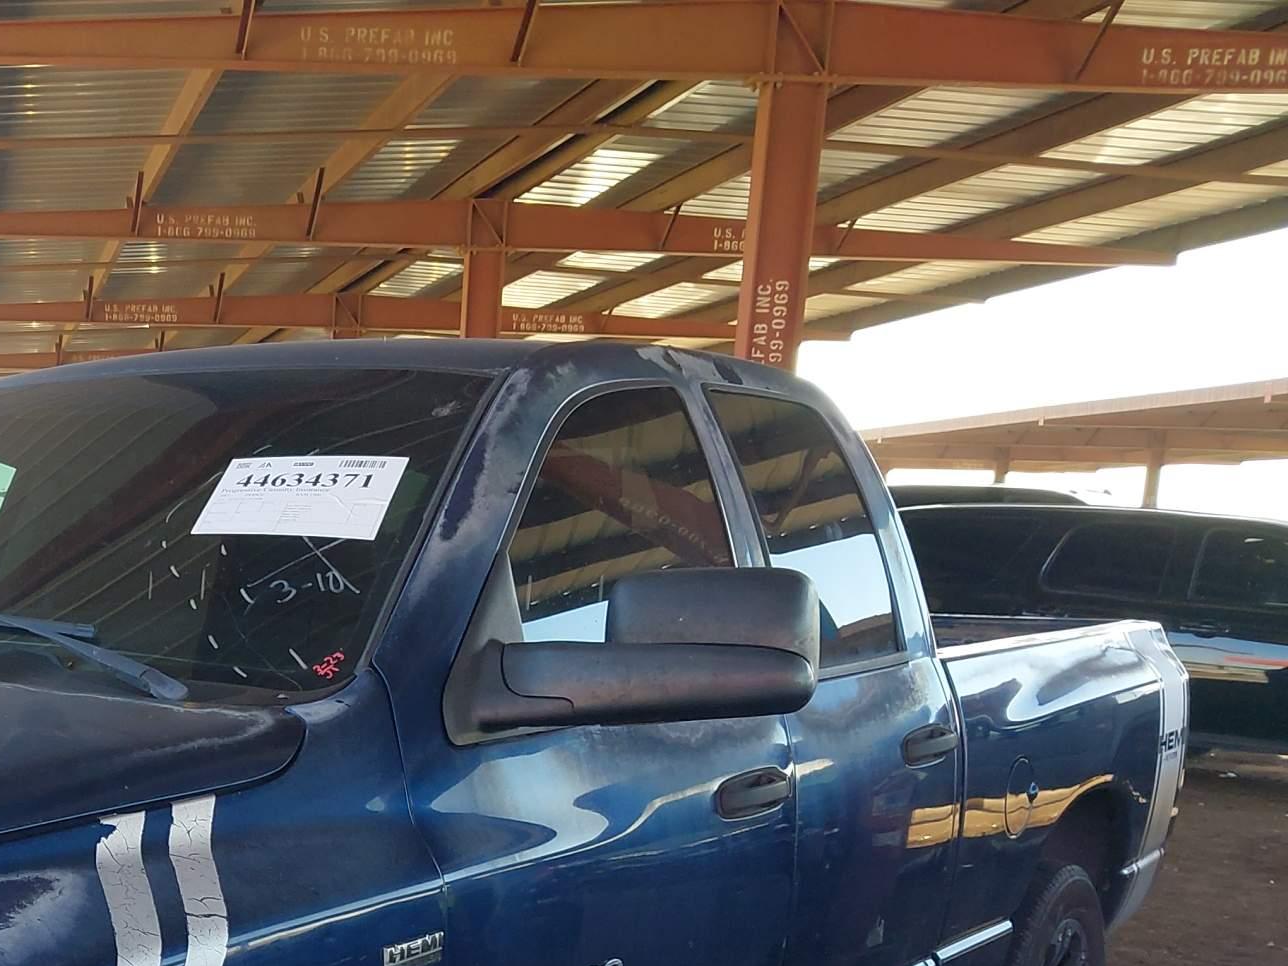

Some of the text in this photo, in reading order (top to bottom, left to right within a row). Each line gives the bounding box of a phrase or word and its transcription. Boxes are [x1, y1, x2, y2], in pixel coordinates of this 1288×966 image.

[1142, 47, 1177, 65] U.S.
[1187, 48, 1261, 66] PREFAB
[713, 227, 736, 239] U.S.
[751, 324, 768, 364] FAB
[236, 473, 374, 489] 44634371
[386, 931, 444, 965] HEMI
